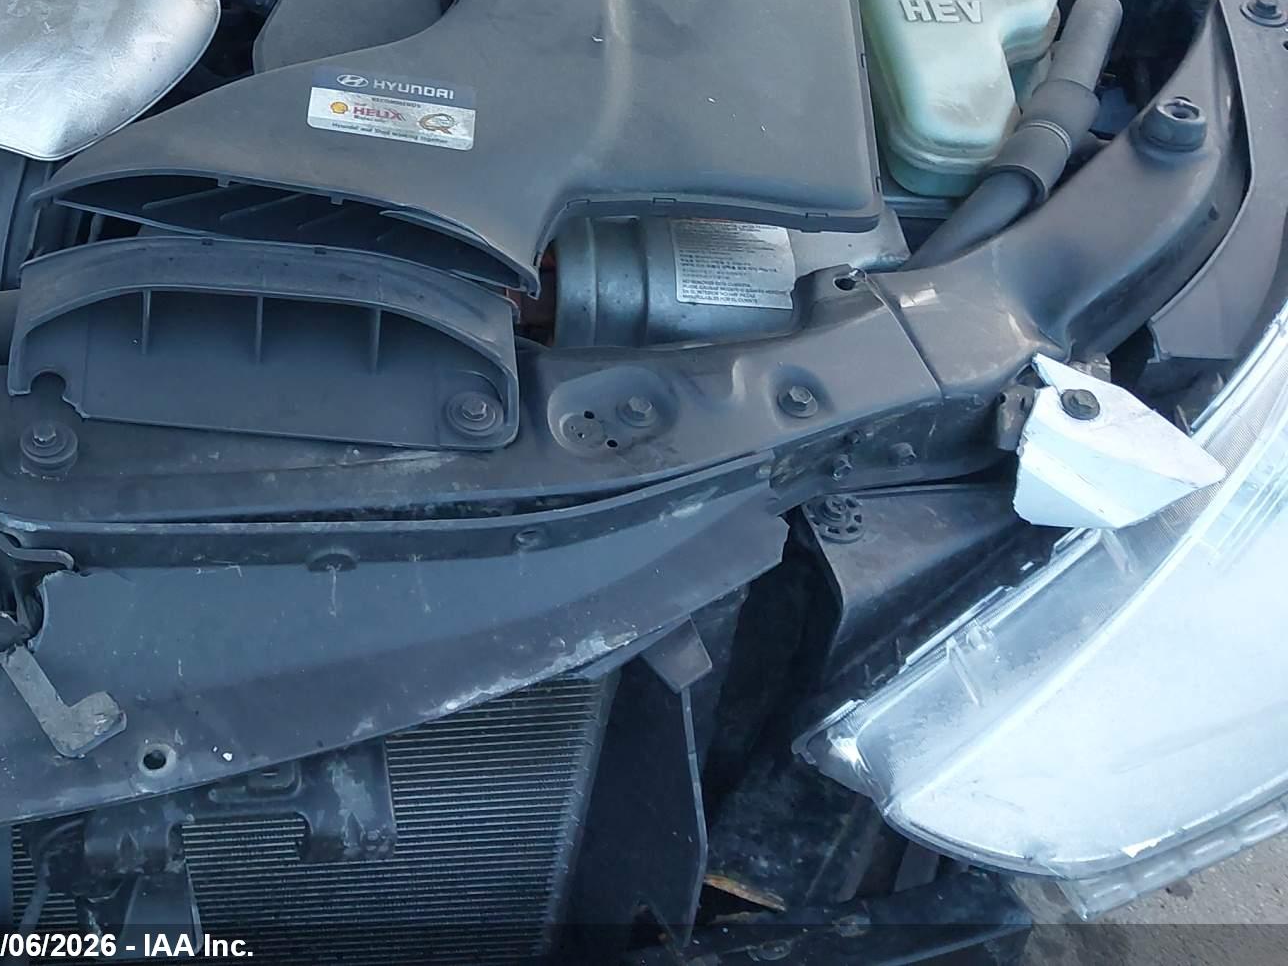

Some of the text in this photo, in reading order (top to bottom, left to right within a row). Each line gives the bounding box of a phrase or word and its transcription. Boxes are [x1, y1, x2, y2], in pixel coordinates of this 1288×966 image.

[899, 0, 982, 23] HEV
[373, 79, 454, 100] HYUNDAI
[353, 106, 403, 122] HELIX
